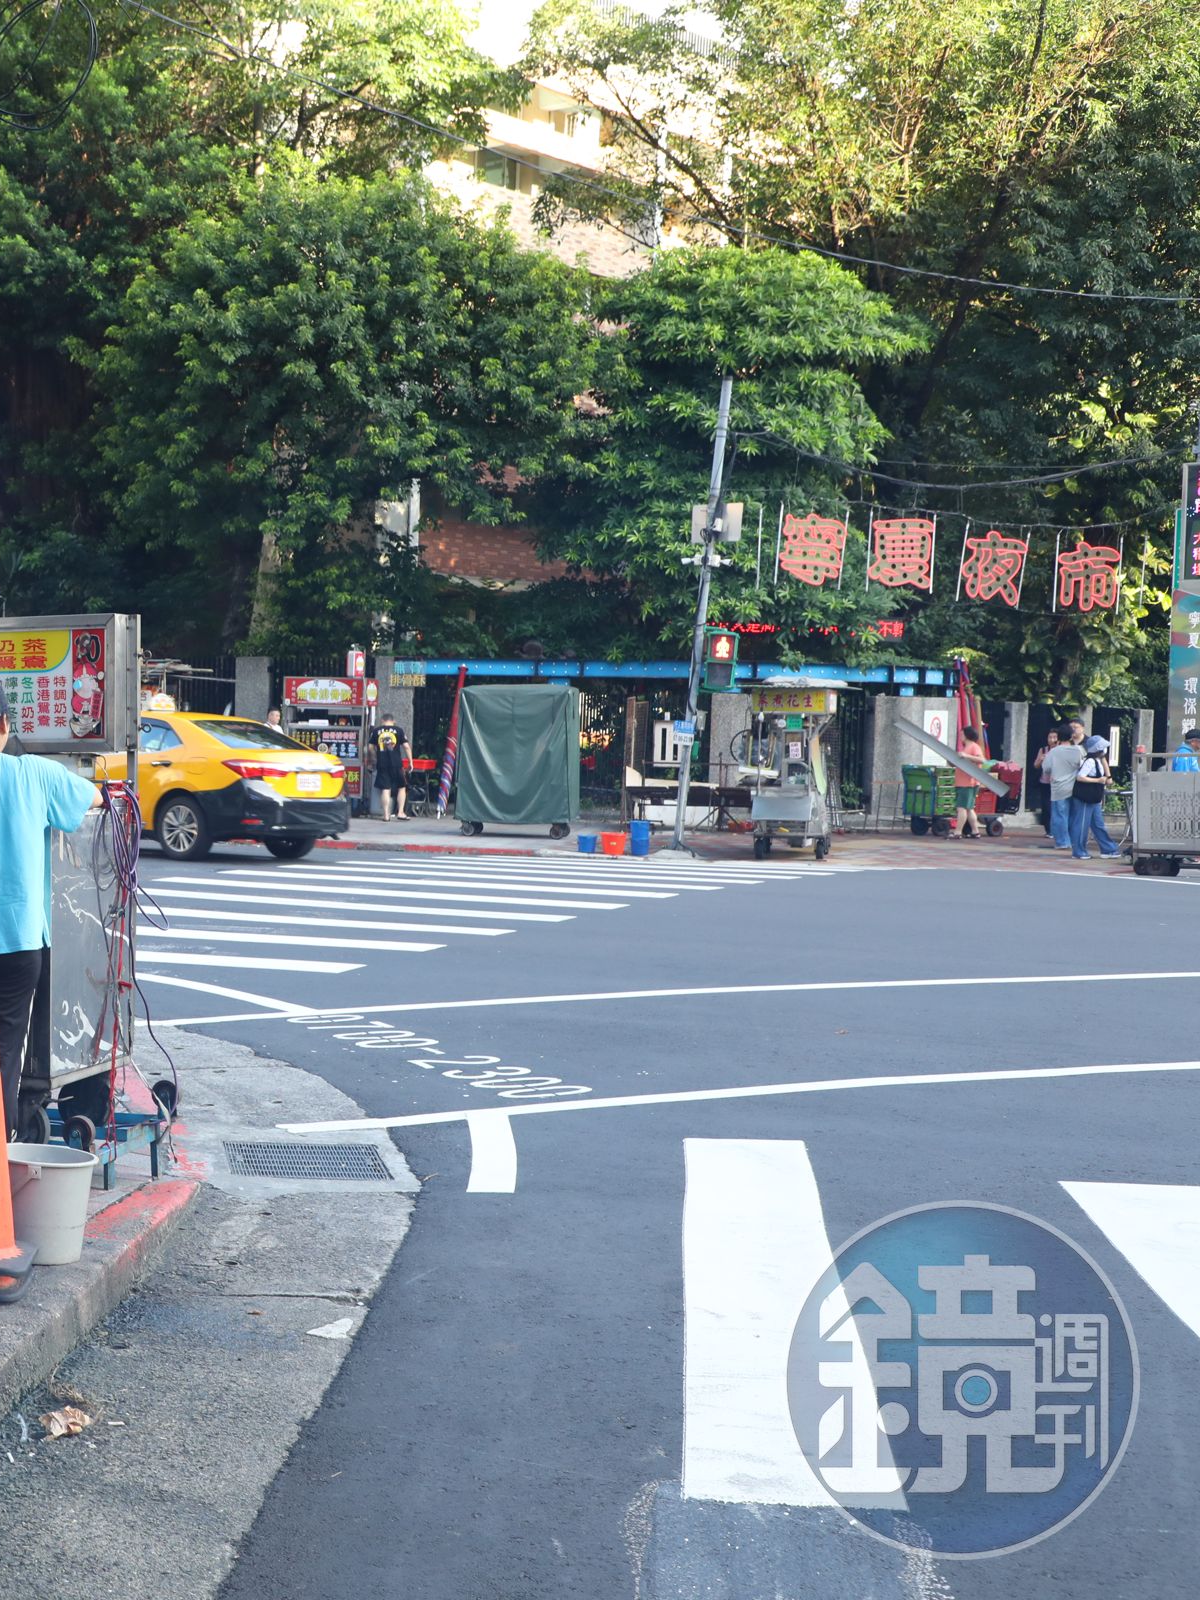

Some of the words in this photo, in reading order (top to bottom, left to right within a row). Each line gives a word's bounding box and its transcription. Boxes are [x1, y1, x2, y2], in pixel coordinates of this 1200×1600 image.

[780, 513, 1121, 612] 寧夏夜市
[1187, 610, 1200, 650] 寧夏
[21, 676, 36, 734] 冬瓜奶茶
[53, 676, 68, 728] 特調奶茶
[287, 1014, 593, 1099] 0700-2300
